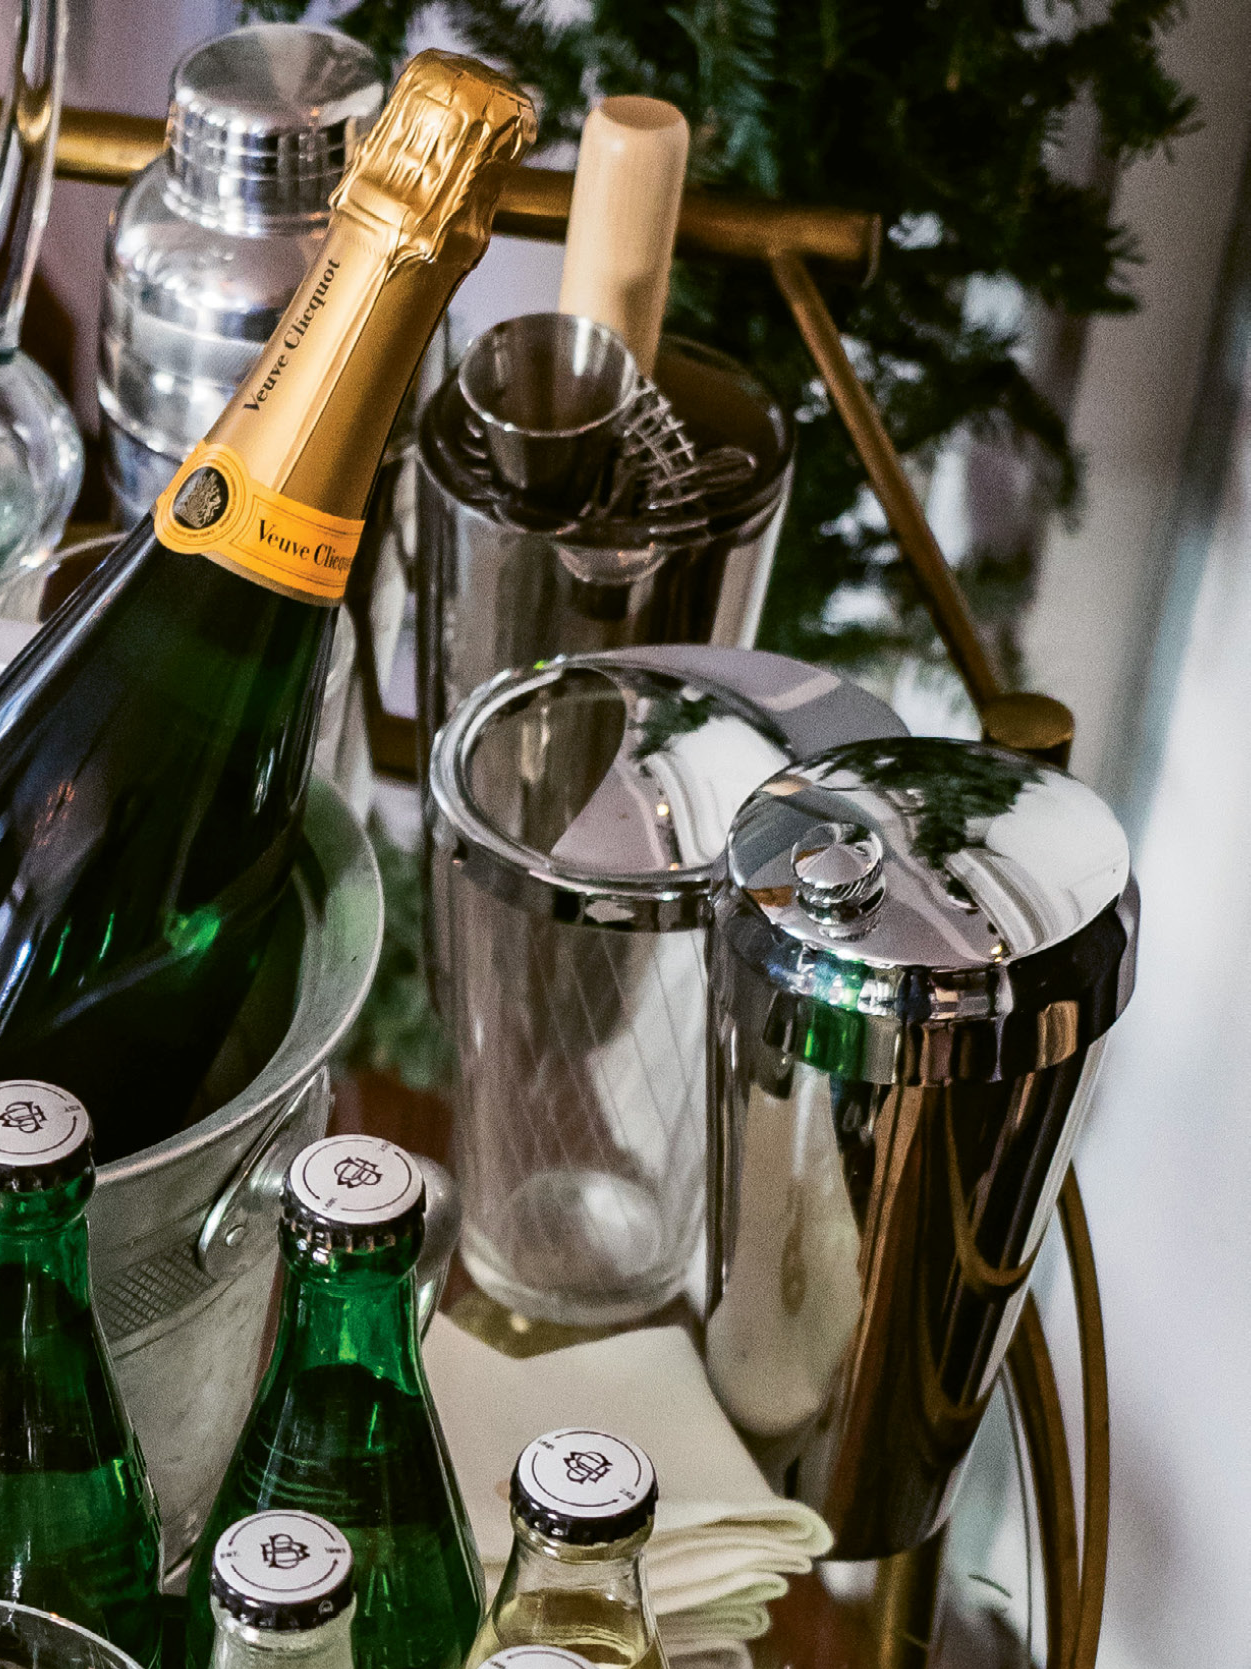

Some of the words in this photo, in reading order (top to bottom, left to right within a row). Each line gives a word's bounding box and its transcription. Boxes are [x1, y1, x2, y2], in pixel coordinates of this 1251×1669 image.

[243, 354, 289, 411] Veuve
[284, 257, 341, 350] Clicquot
[259, 519, 310, 560] Veuve
